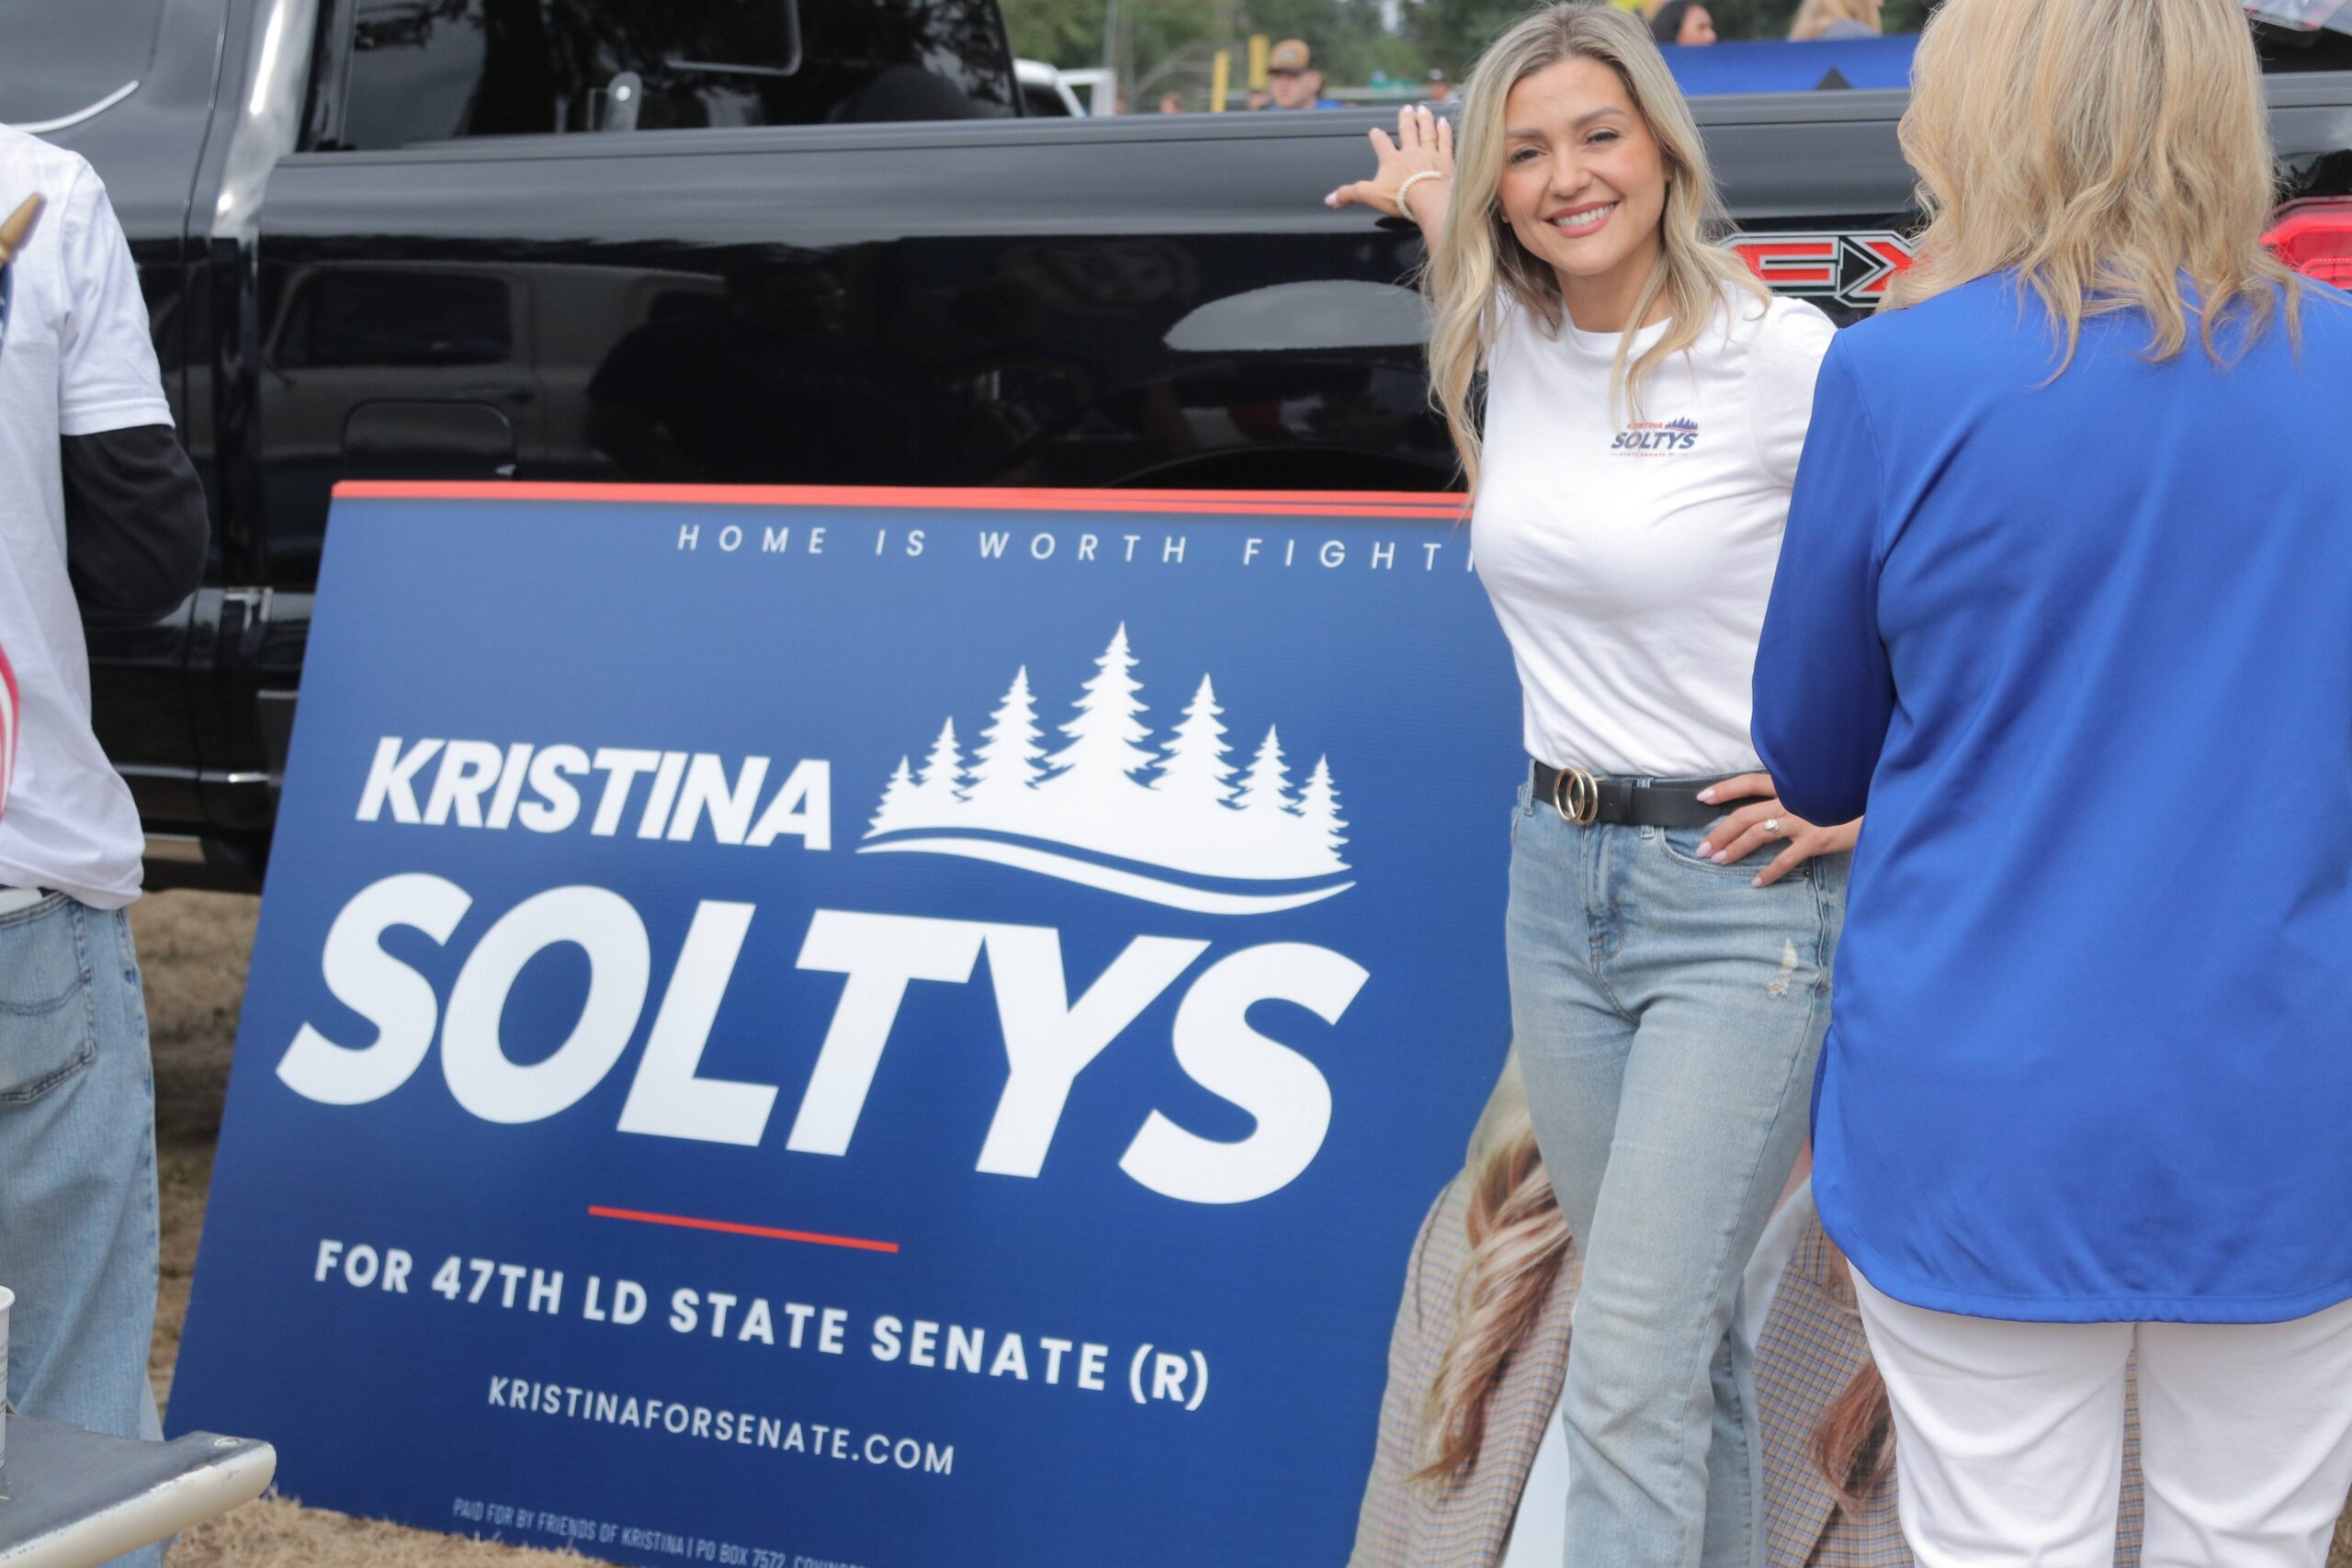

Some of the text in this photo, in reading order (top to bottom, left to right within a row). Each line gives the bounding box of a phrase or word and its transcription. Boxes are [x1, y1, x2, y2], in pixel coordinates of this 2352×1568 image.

[1611, 432, 1698, 449] SOLTYS
[677, 524, 827, 554] HOME
[876, 528, 925, 557] IS
[979, 531, 1186, 564] WORTH
[356, 736, 831, 852] KRISTINA
[276, 873, 1370, 1205] SOLTYS
[315, 1240, 1208, 1411] FOR 47TH LD STATE SENATE (R)
[489, 1378, 954, 1474] KRISTINAFORSENATE.COM
[453, 1497, 484, 1521] PAID
[486, 1503, 514, 1526] FOR
[515, 1507, 535, 1529] BY
[537, 1512, 596, 1540] FRIENDS
[598, 1522, 619, 1543] OF
[621, 1526, 684, 1555] KRISTINA
[695, 1539, 716, 1561] PO
[718, 1542, 749, 1567] BOX
